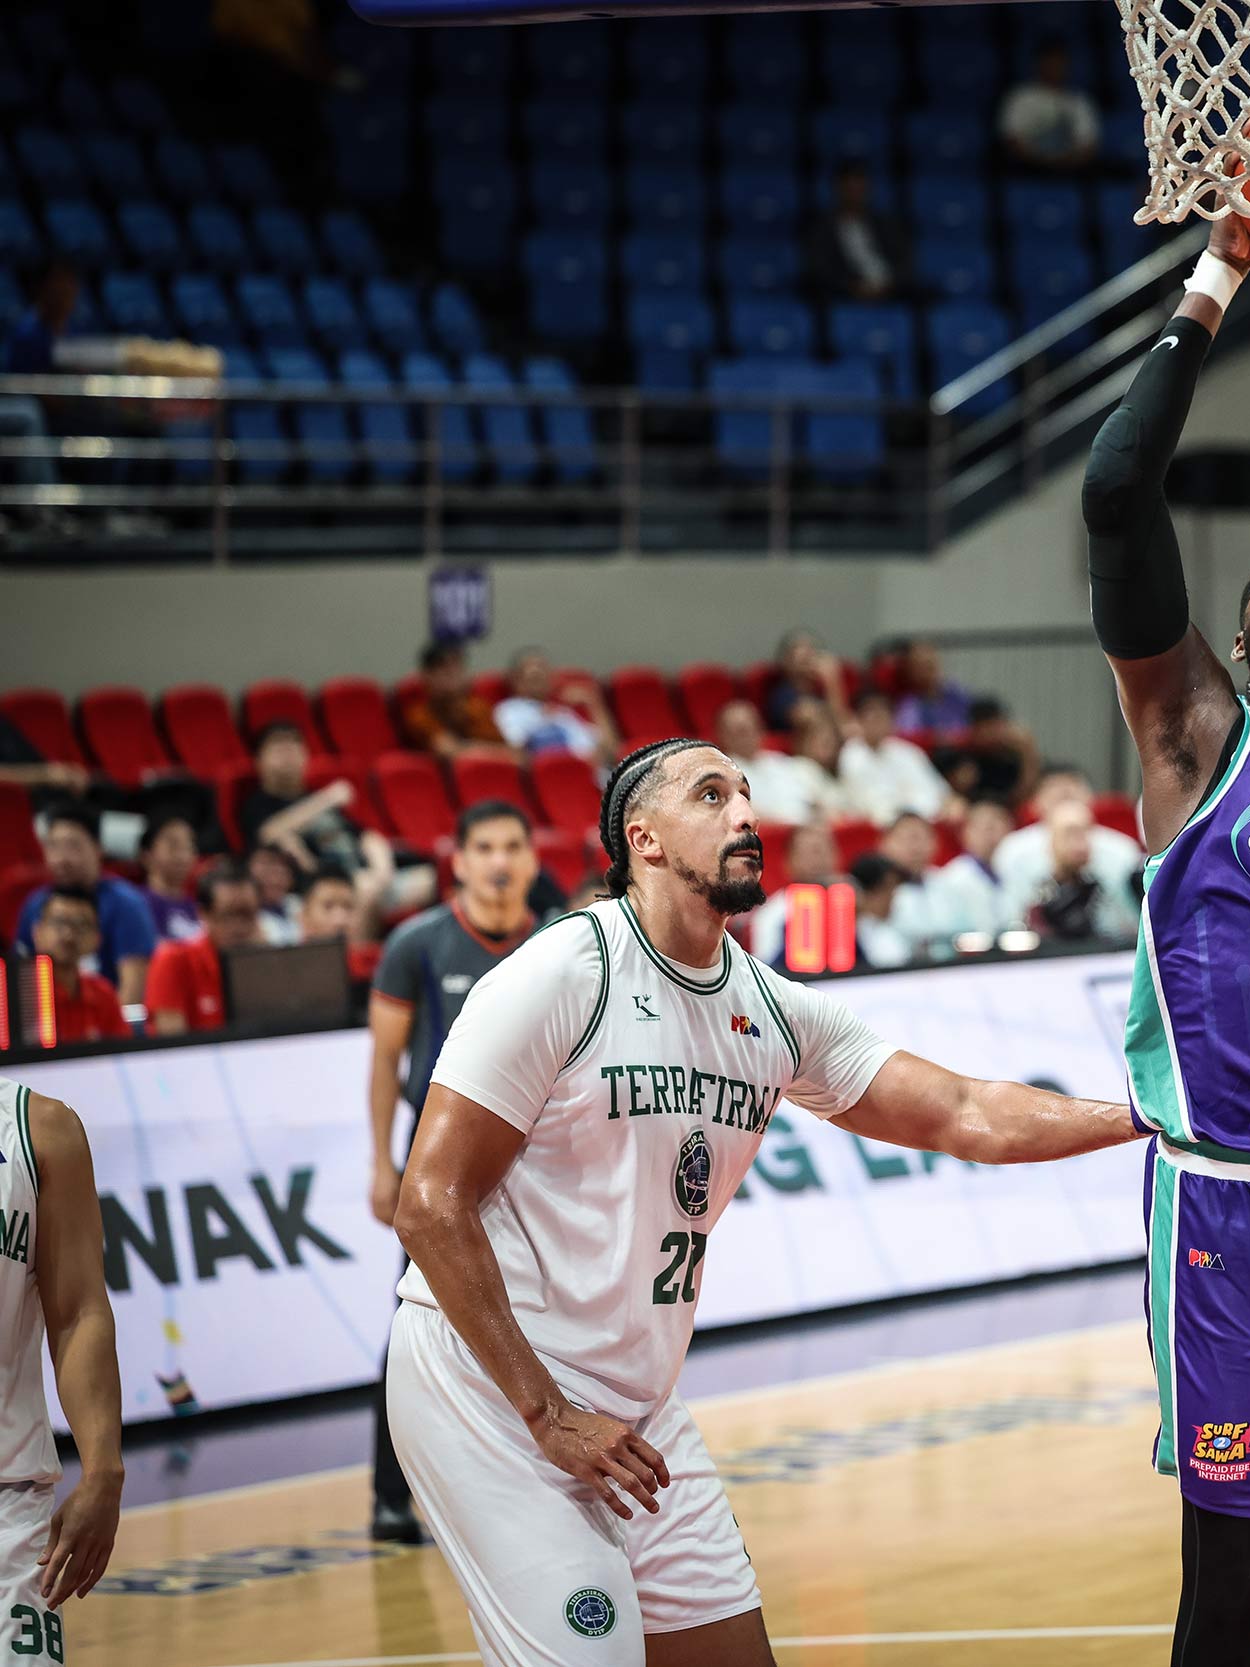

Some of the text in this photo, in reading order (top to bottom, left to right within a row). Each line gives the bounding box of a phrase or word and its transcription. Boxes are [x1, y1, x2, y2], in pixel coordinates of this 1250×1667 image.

[1201, 1422, 1248, 1440] SURF
[1217, 1437, 1226, 1448] 2
[1194, 1441, 1245, 1463] SAWA
[1189, 1459, 1229, 1473] PREPAID
[1198, 1470, 1245, 1481] INTERNET
[10, 1603, 64, 1665] 38
